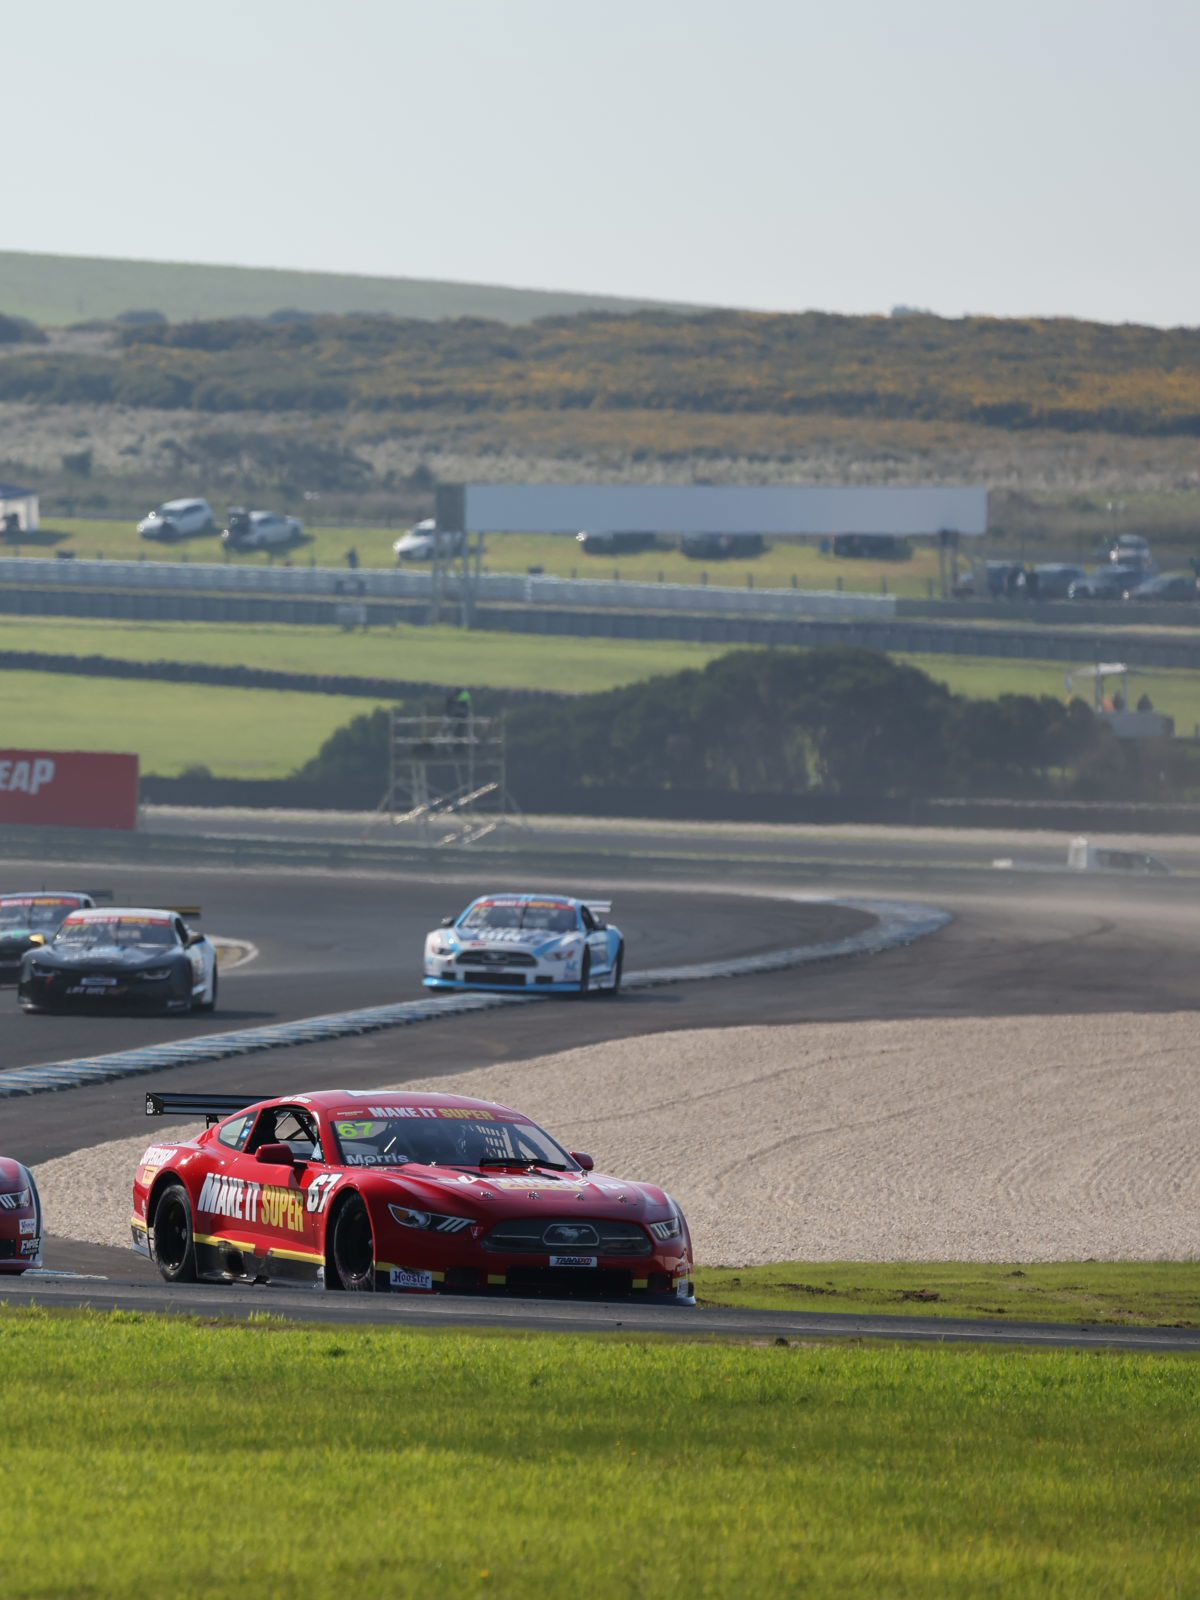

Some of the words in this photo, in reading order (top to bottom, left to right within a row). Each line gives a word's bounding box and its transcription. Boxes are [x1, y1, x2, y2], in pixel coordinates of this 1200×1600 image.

[368, 1107, 416, 1118] MAKE
[419, 1107, 439, 1118] IT
[439, 1108, 495, 1120] SUPER
[338, 1122, 374, 1138] 67
[345, 1153, 409, 1165] Morris
[306, 1173, 343, 1213] 67
[197, 1173, 244, 1220] MAKE
[244, 1181, 261, 1222] IT
[261, 1184, 304, 1232] SUPER
[392, 1268, 431, 1284] Hoosier
